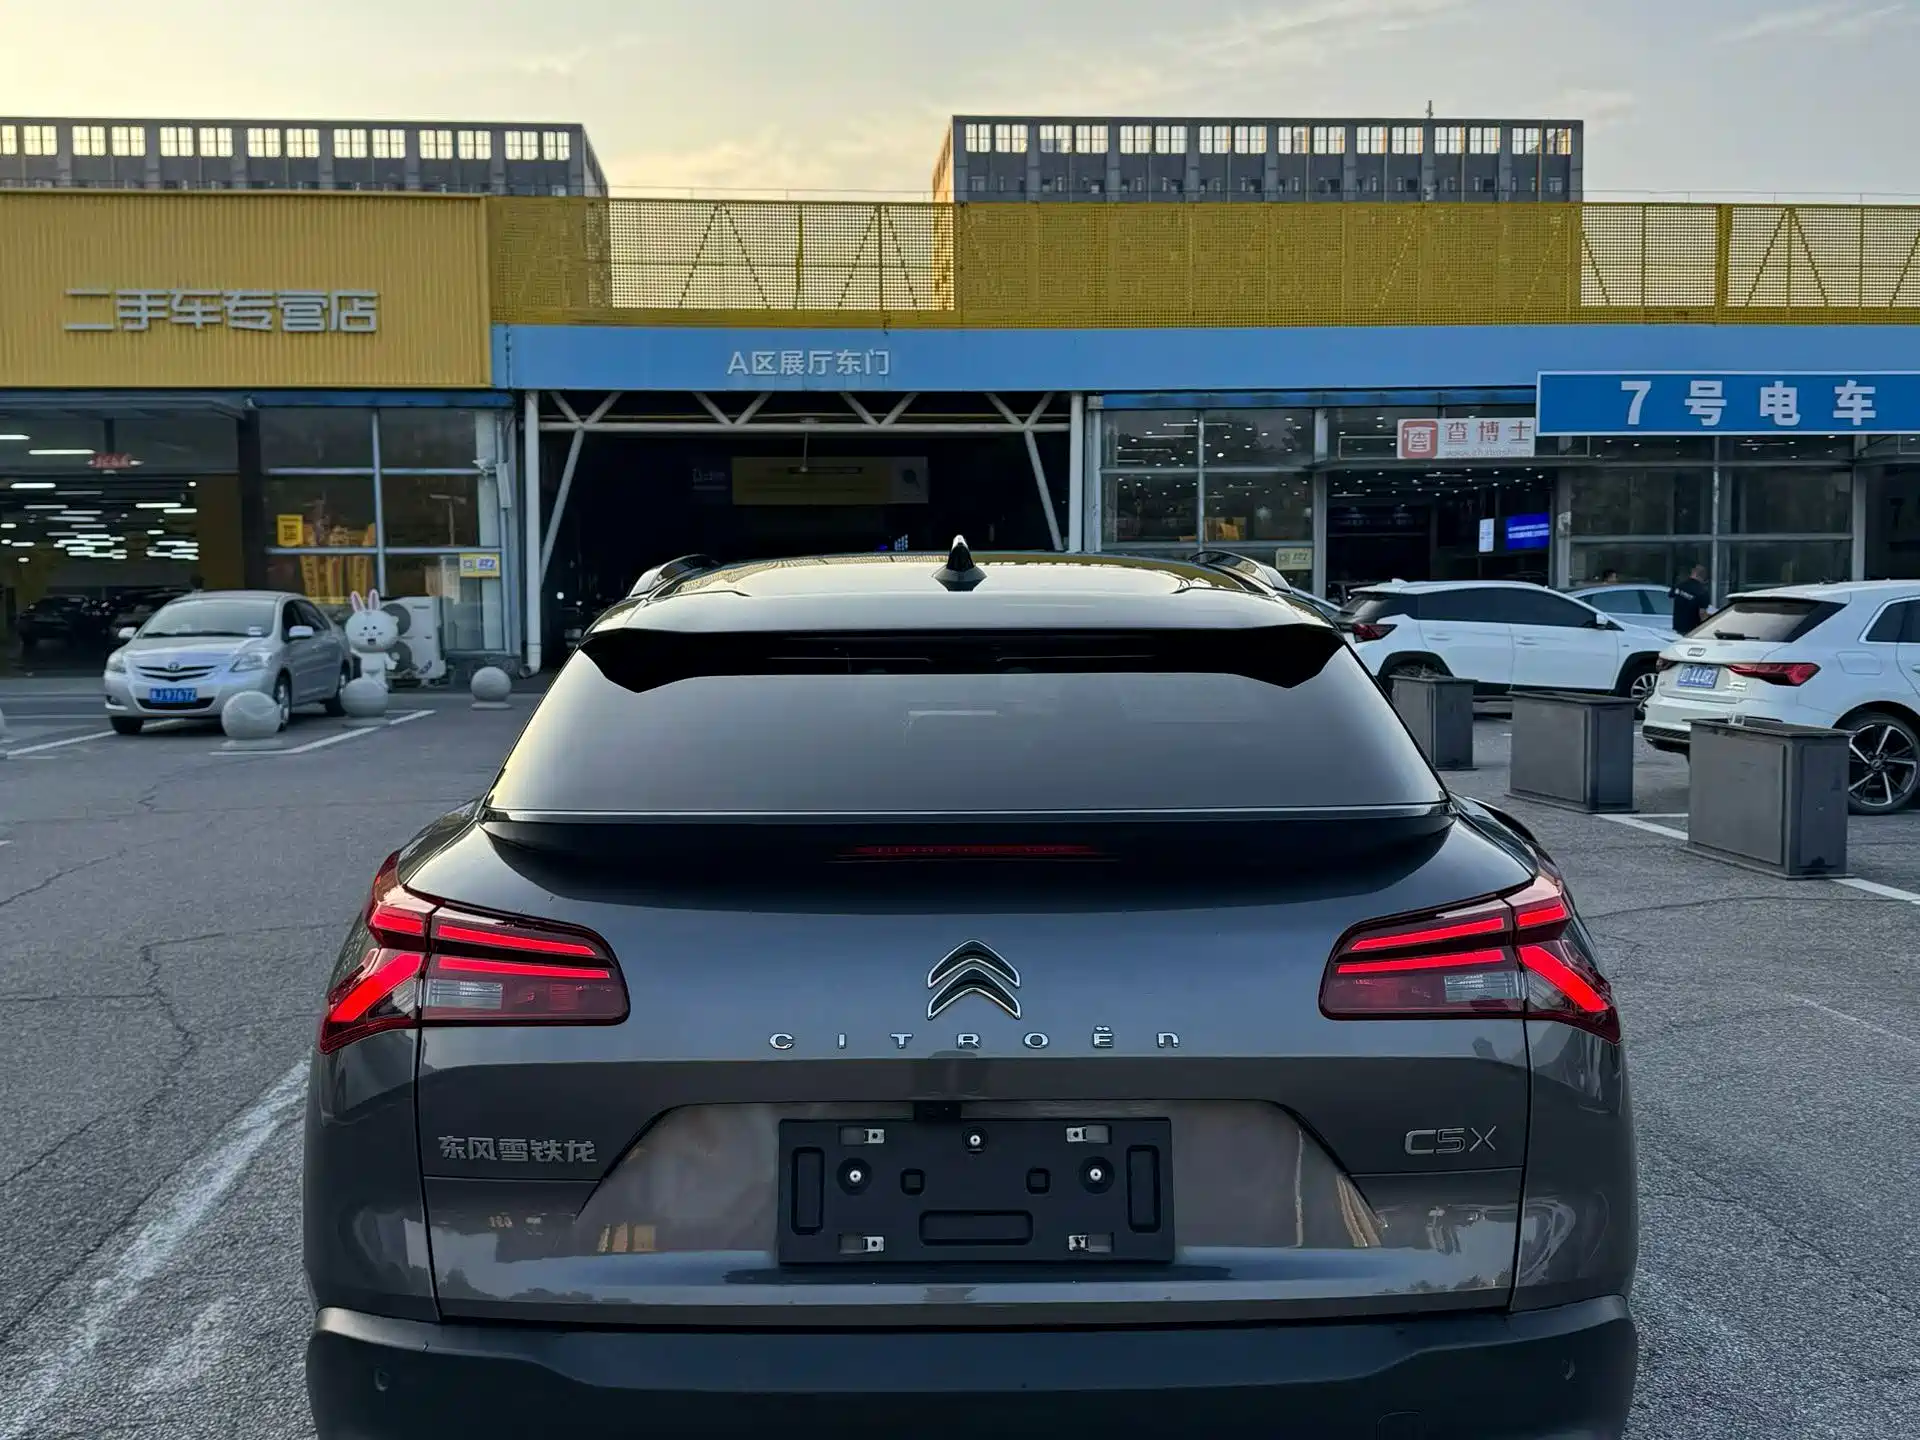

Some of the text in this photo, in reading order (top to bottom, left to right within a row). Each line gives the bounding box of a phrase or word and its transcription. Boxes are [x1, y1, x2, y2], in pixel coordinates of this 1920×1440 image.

[64, 288, 378, 332] 二手车专营店
[727, 349, 890, 376] A区展厅东门
[1446, 421, 1532, 443] 查博士
[437, 1136, 597, 1162] 东风雪铁龙
[1405, 1126, 1497, 1155] C5X
